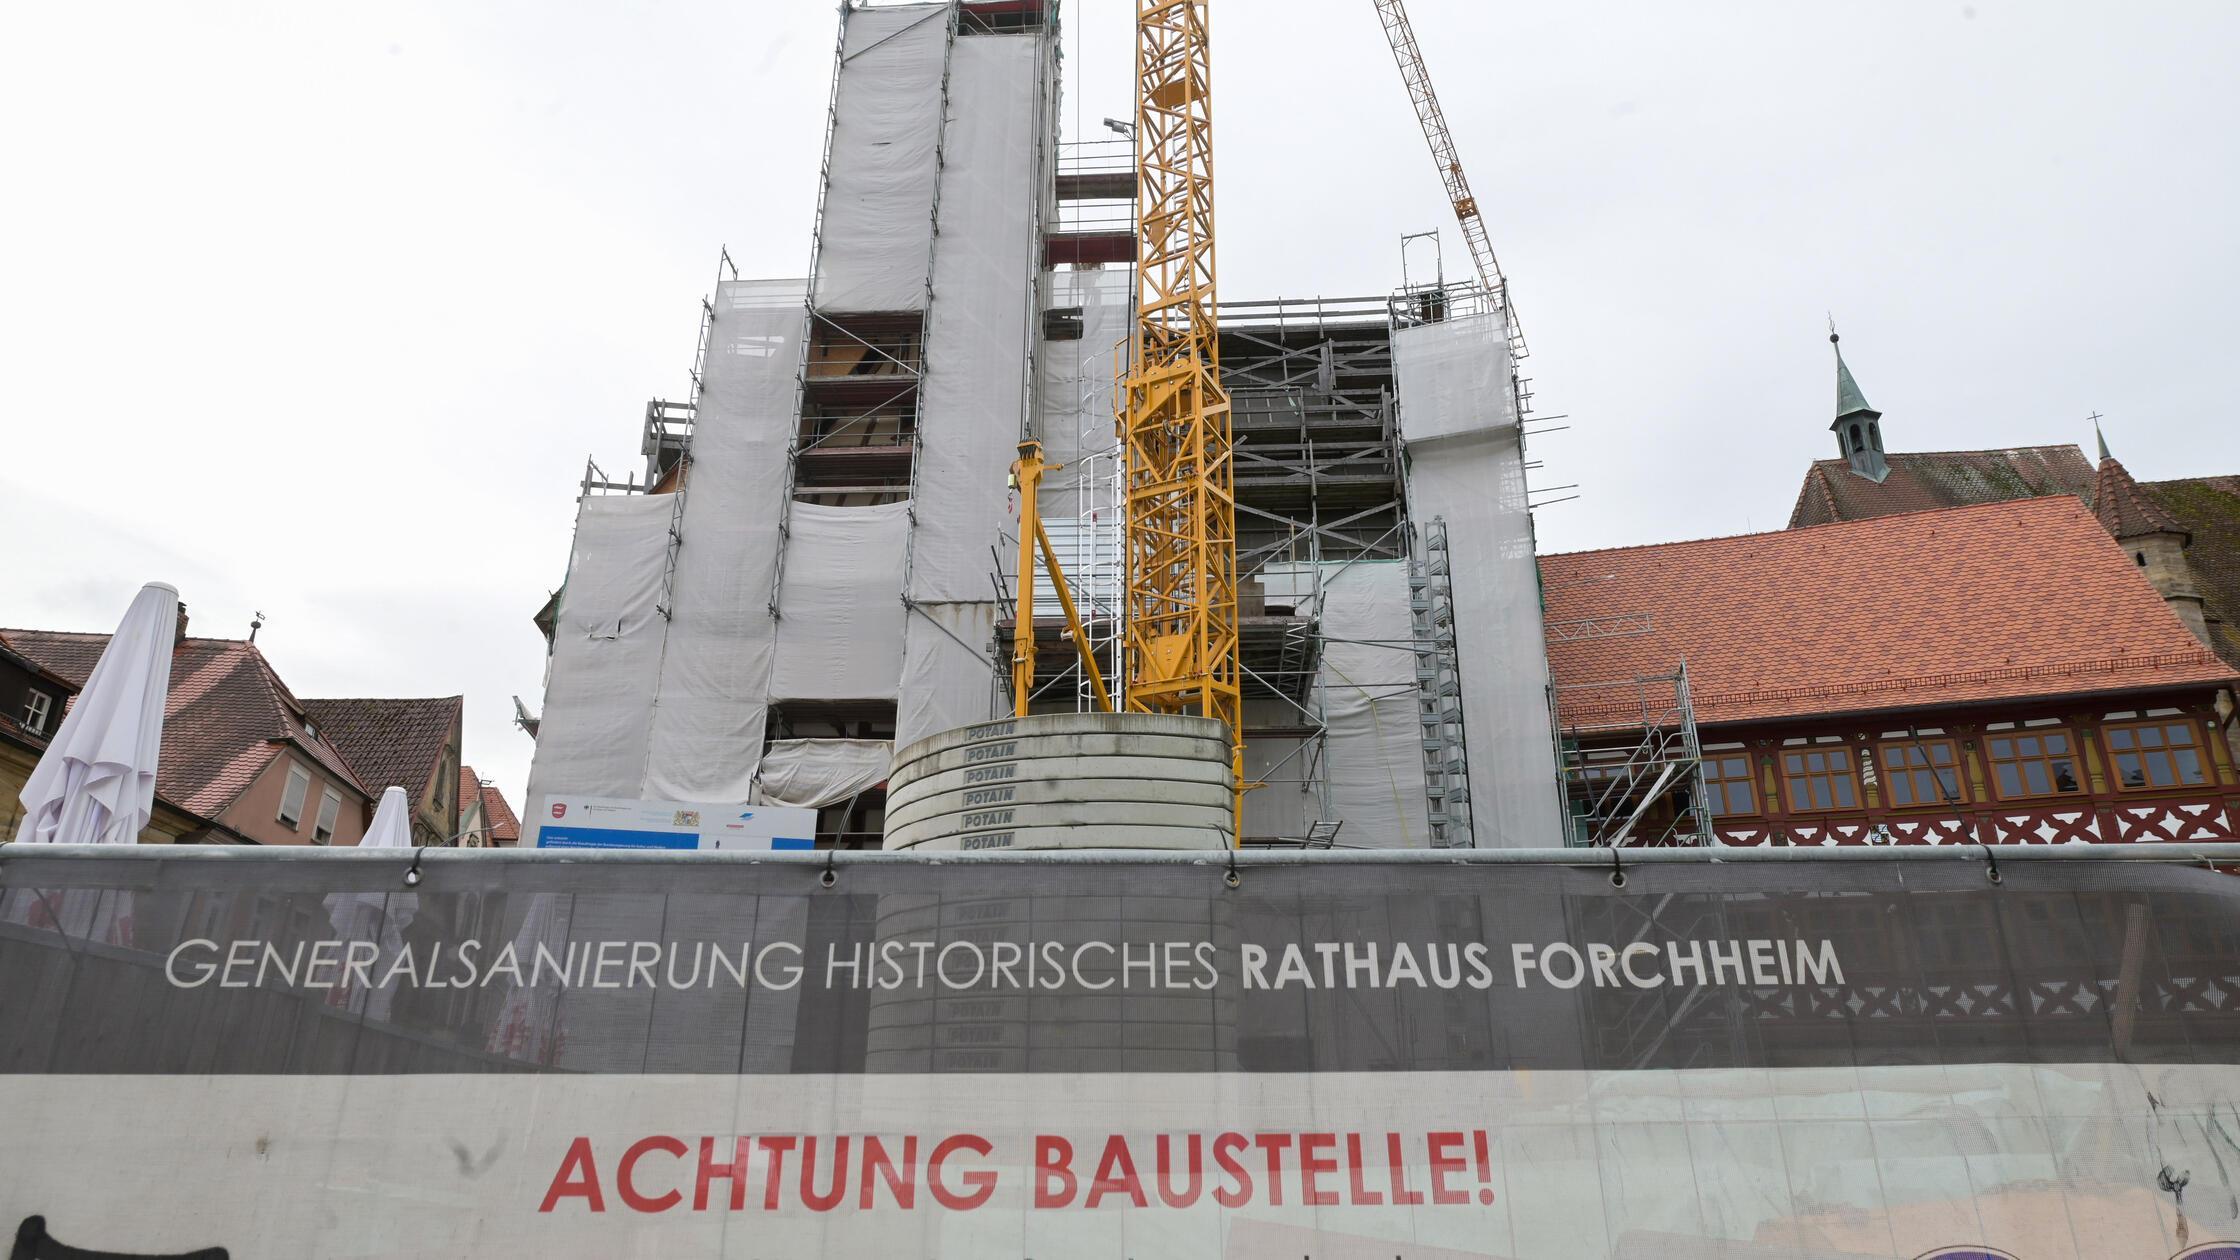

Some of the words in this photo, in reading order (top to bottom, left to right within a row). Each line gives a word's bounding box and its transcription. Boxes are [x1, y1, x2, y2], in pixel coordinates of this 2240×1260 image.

[968, 720, 1015, 741] POTAIN
[967, 742, 1015, 762] POTAIN
[967, 765, 1015, 784] POTAIN
[966, 788, 1014, 806] POTAIN
[964, 811, 1013, 828] POTAIN
[963, 833, 1012, 850] POTAIN
[165, 938, 804, 991] GENERALSANIERUNG
[826, 941, 1219, 990] HISTORISCHES
[1241, 942, 1493, 989] RATHAUS
[1511, 939, 1845, 989] FORCHHEIM
[539, 1134, 997, 1213] ACHTUNG
[1035, 1130, 1492, 1208] BAUSTELLE!
